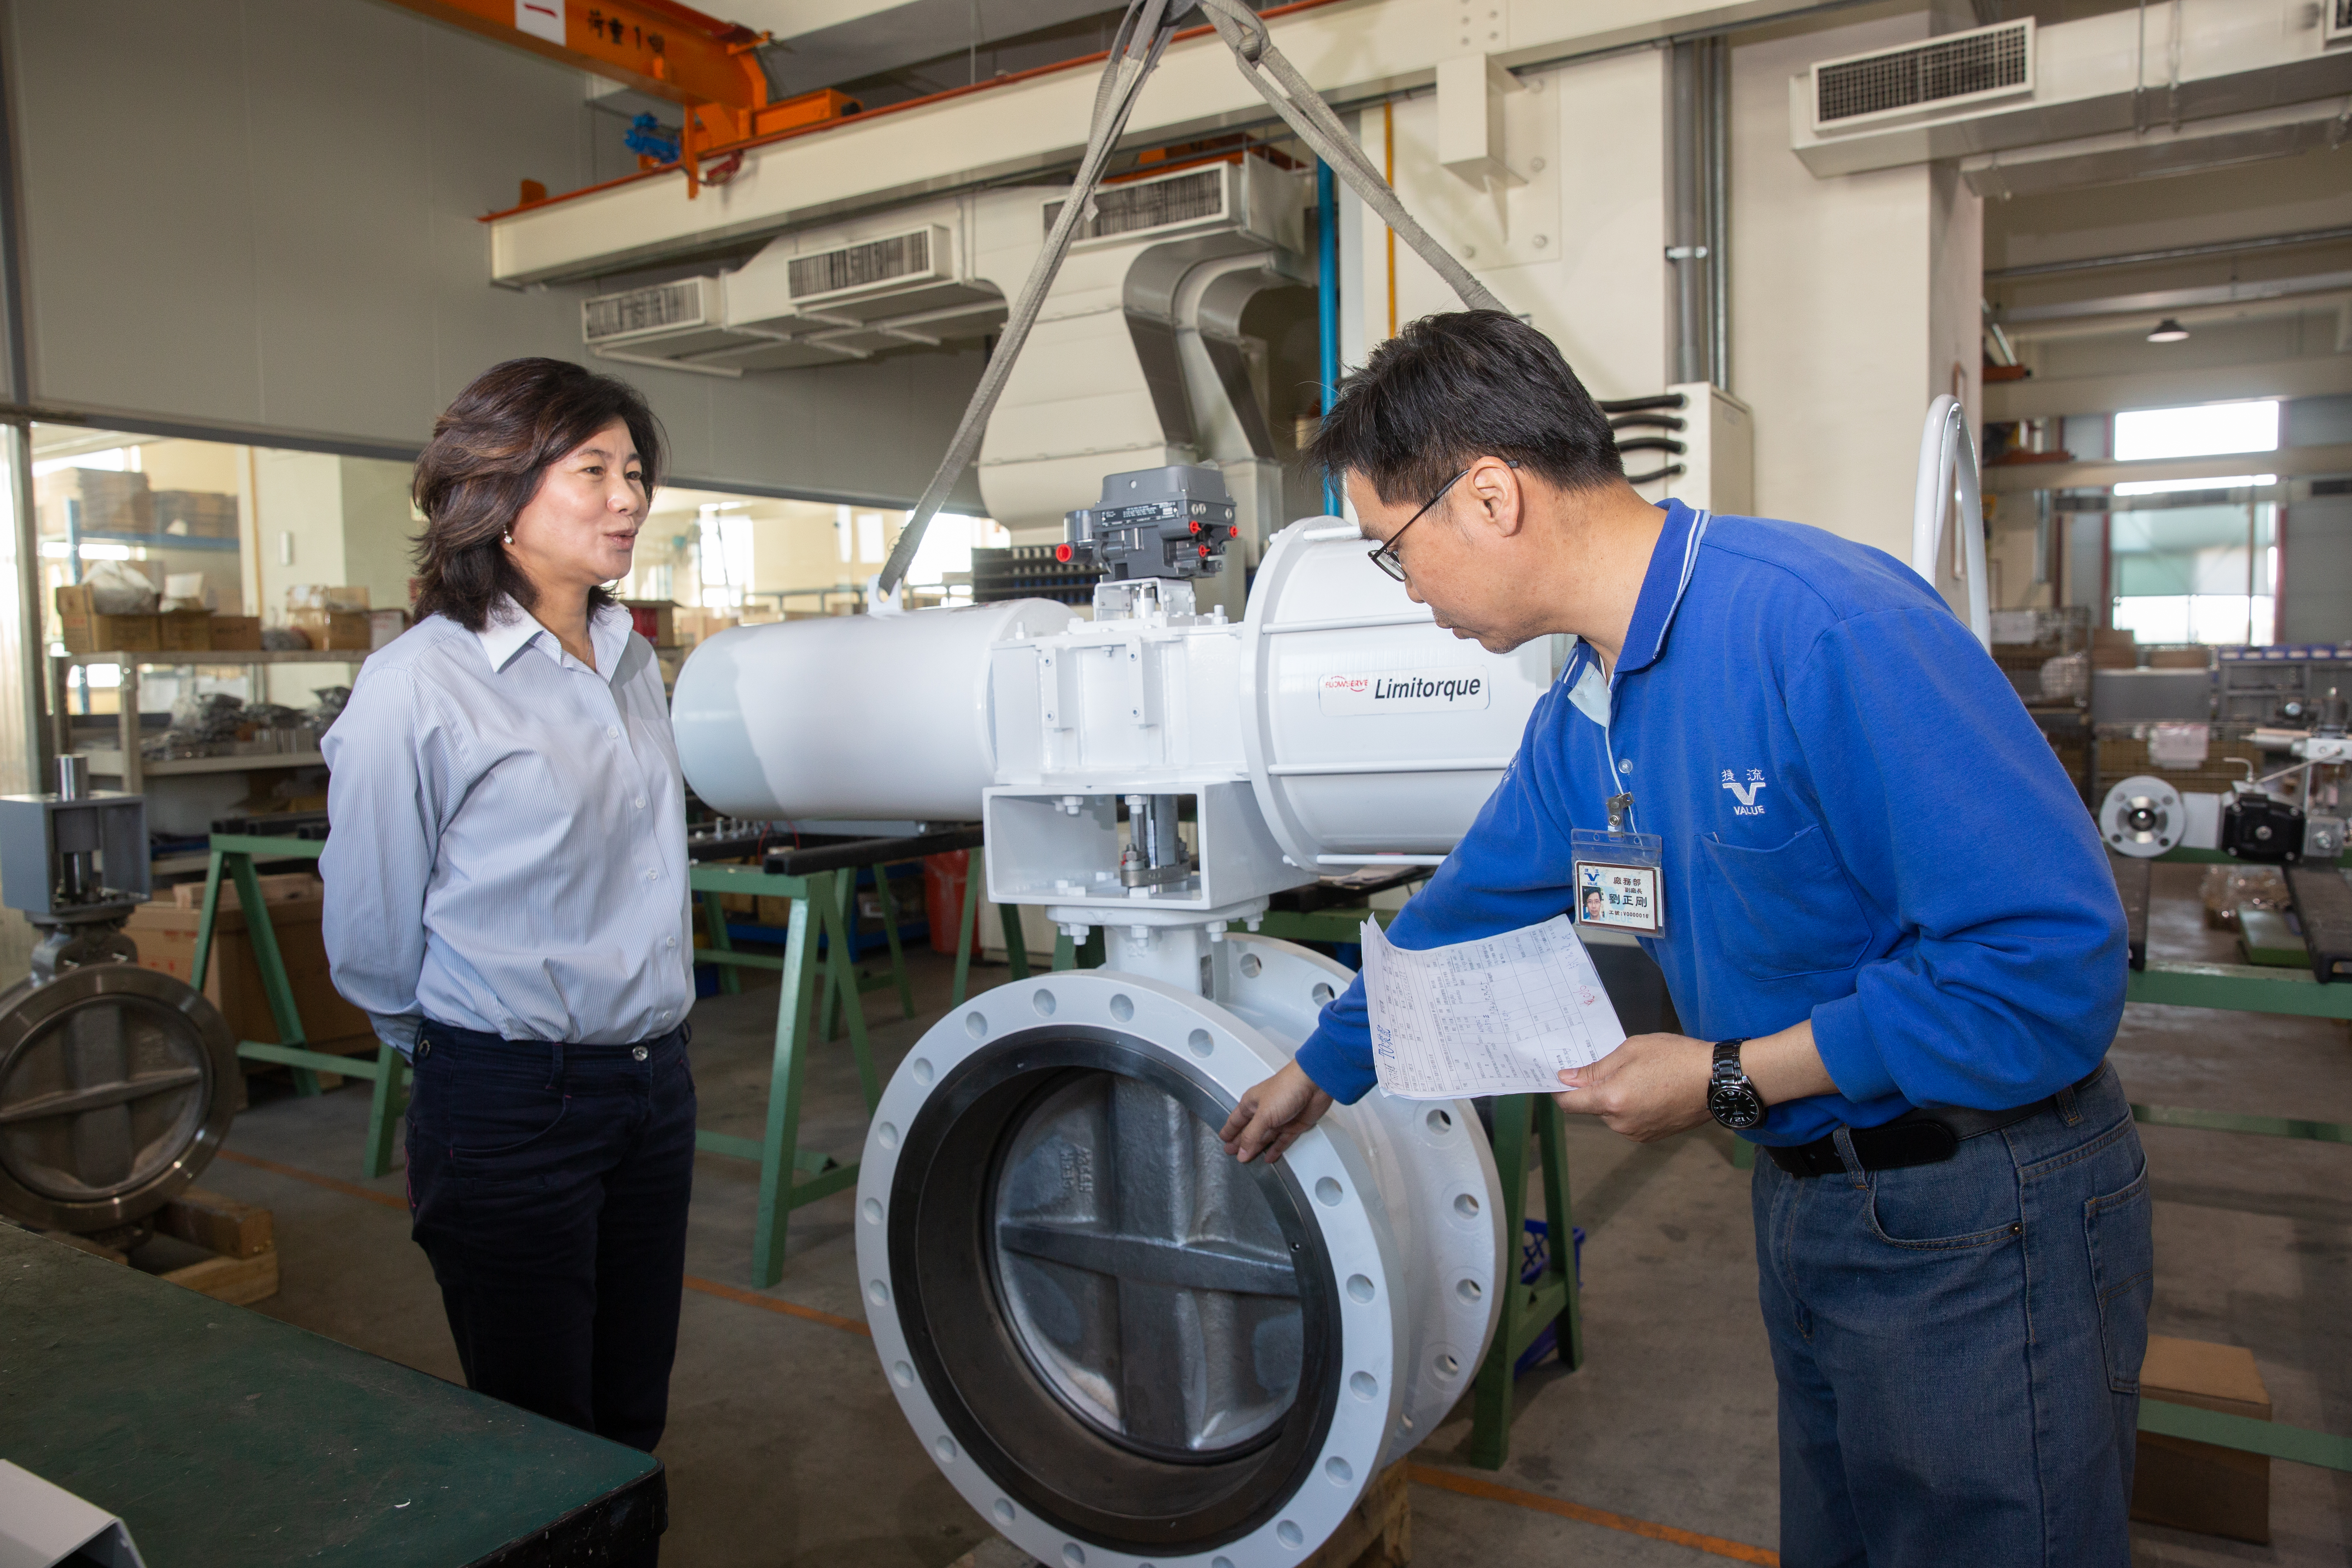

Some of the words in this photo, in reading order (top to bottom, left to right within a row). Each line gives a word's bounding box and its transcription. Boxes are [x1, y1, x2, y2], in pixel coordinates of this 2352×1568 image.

[1375, 677, 1481, 702] Limitorque
[1733, 805, 1765, 815] VALUE
[1613, 877, 1641, 886] 廠務部
[1609, 893, 1647, 907] 劉正剛
